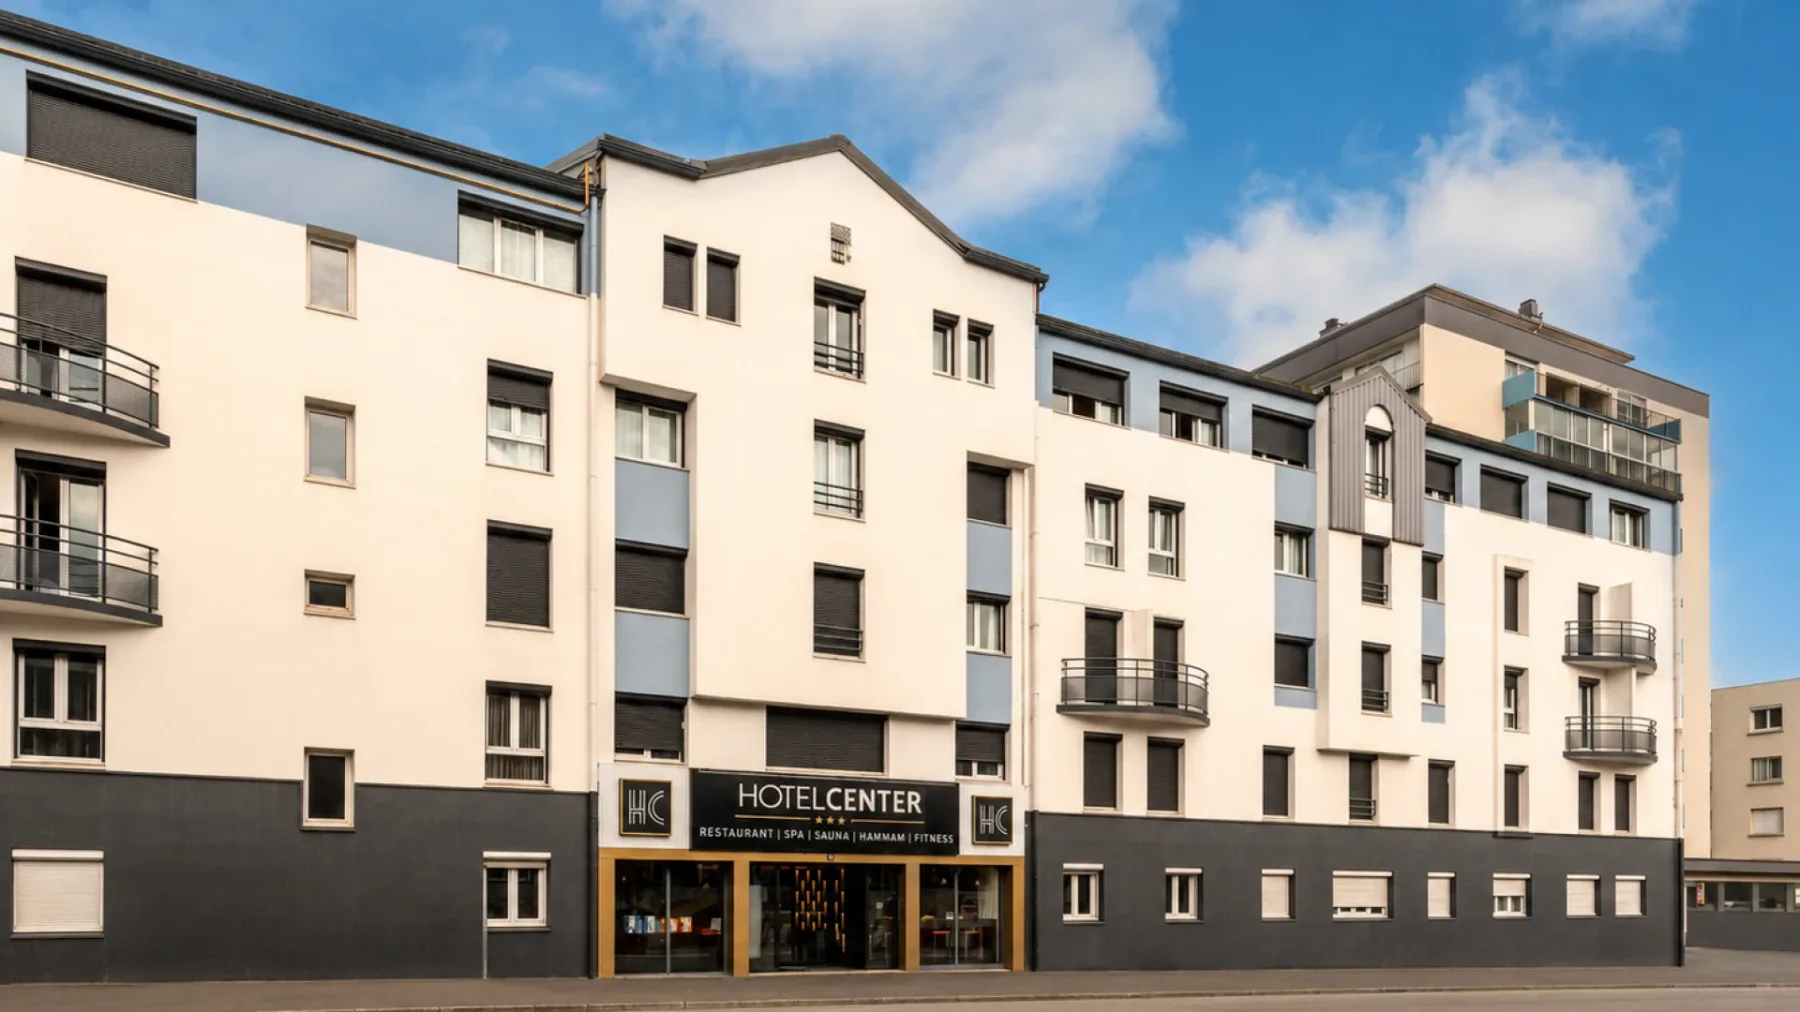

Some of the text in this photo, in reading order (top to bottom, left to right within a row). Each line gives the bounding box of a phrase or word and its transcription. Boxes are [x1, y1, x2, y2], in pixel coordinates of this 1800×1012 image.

[628, 789, 664, 825] HC
[980, 804, 1008, 835] HC
[700, 827, 954, 844] RESTAURANT SPA SAUNA HAMMAM FITNESS
